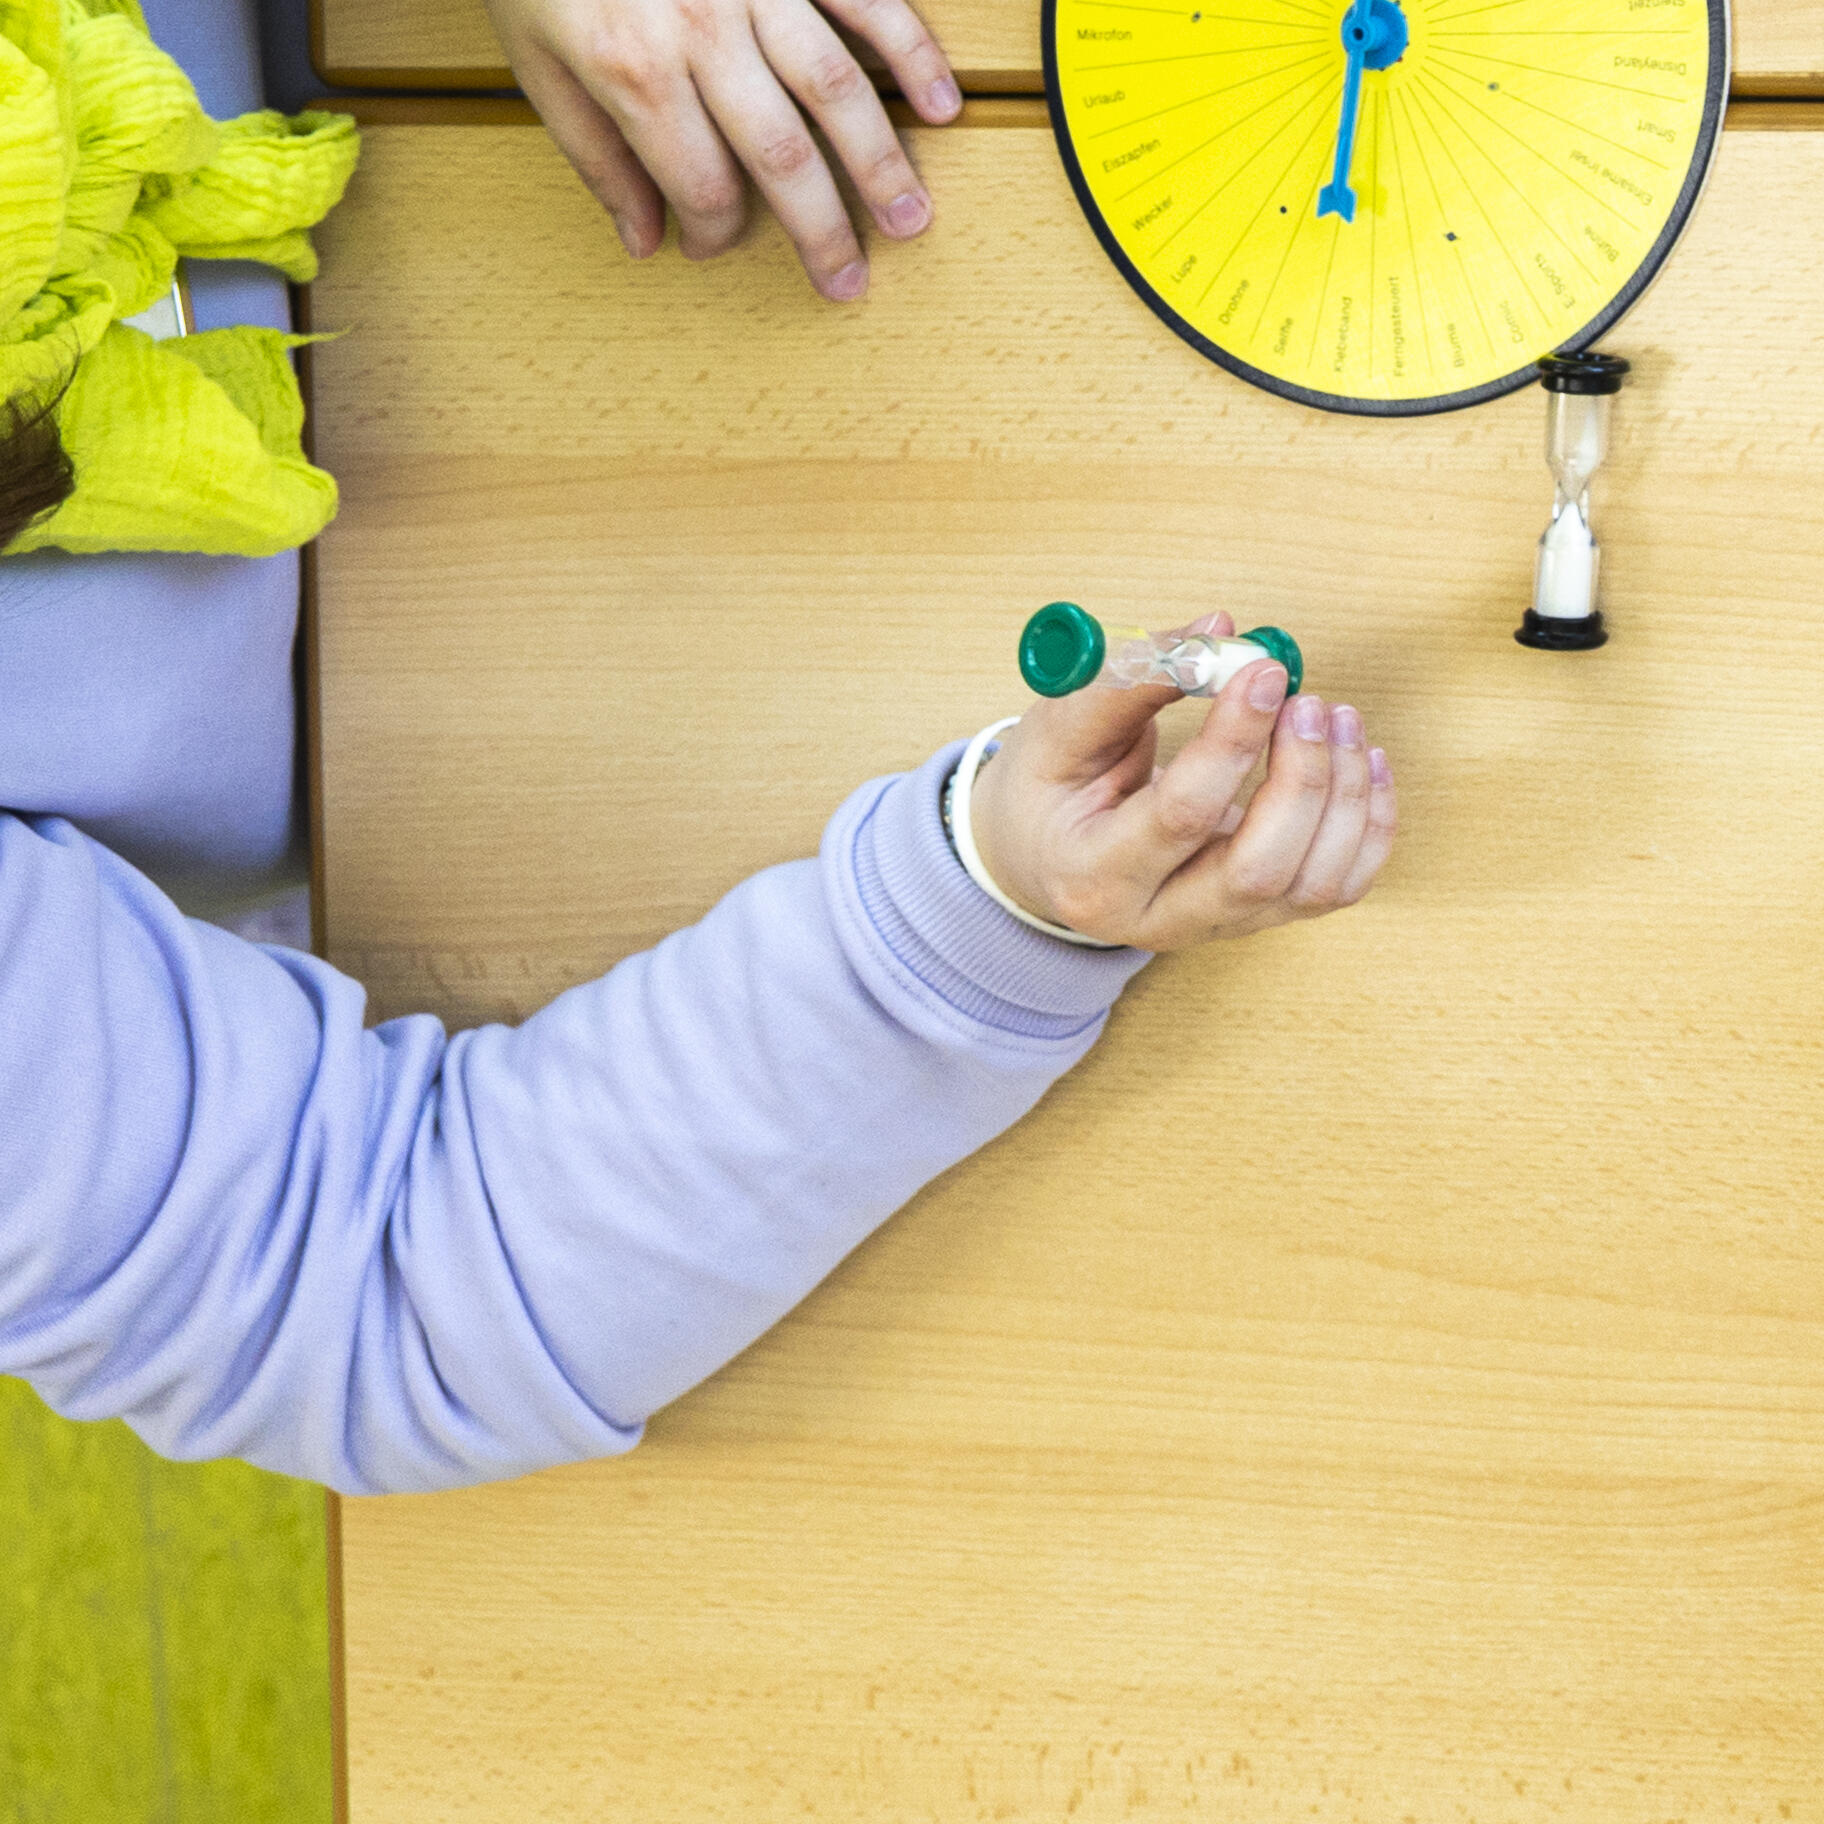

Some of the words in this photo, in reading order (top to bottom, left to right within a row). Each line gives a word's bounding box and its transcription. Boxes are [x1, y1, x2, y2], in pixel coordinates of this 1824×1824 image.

[1076, 29, 1132, 41] Mikrofon
[1614, 56, 1686, 76] Disneyland
[1083, 90, 1125, 109] Urlaub
[1637, 120, 1676, 142] Smart
[1102, 139, 1161, 173] Eiszapfen
[1132, 196, 1172, 231] Wecker
[1171, 255, 1197, 284] Lupe
[1218, 279, 1249, 325] Drohne
